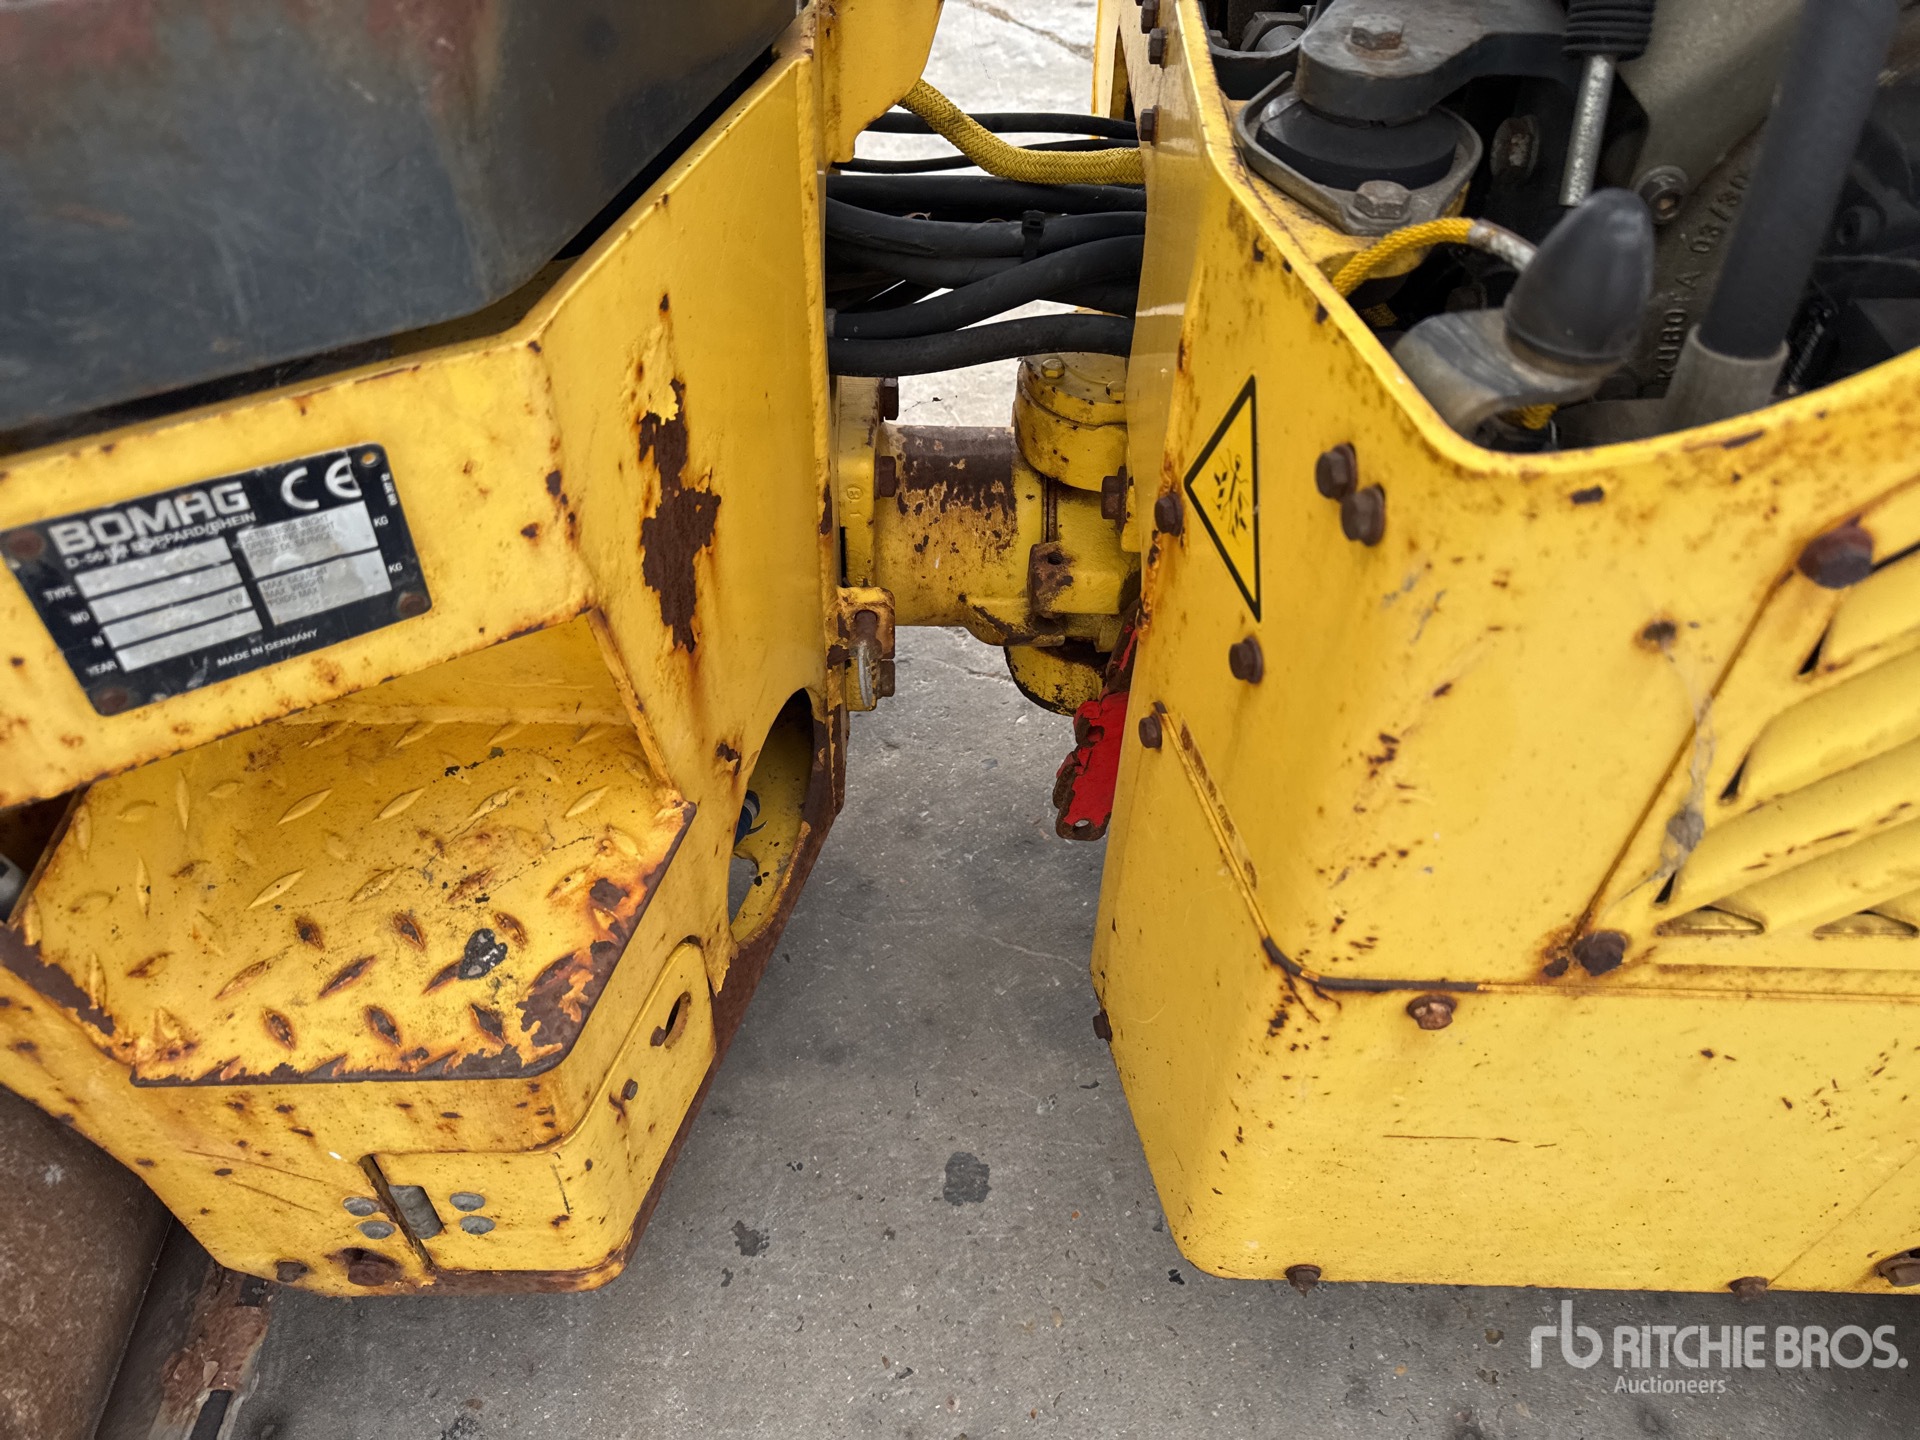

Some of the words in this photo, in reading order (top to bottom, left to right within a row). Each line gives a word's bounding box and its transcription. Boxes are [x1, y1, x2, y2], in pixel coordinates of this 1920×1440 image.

[1656, 270, 1701, 380] KUBOTA
[281, 457, 362, 510] CE
[48, 481, 251, 556] BOMAG
[374, 515, 389, 527] KG
[388, 562, 403, 574] KG
[217, 650, 250, 668] MADE
[251, 645, 264, 656] IN
[264, 629, 318, 652] GERMANY
